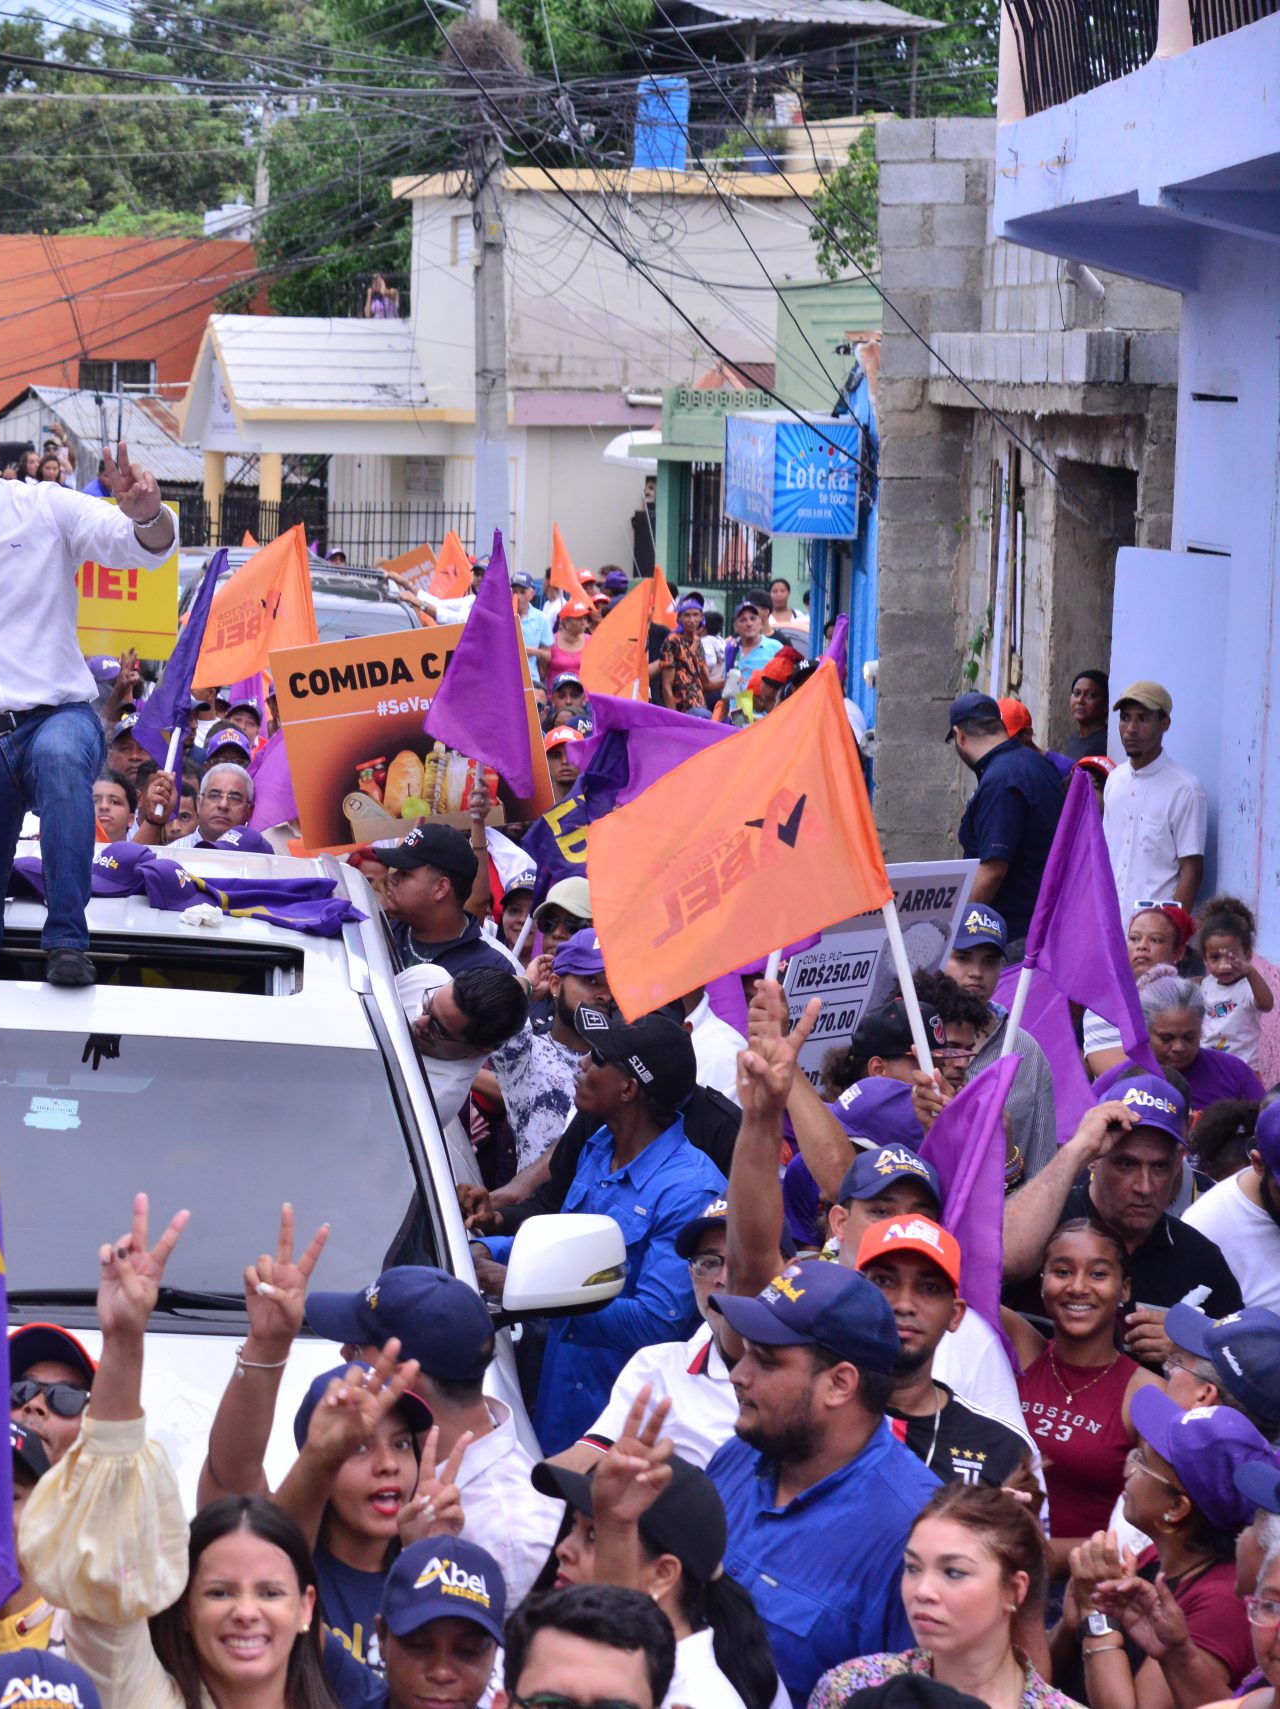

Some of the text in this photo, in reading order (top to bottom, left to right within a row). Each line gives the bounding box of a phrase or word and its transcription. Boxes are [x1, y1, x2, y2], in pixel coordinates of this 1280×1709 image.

[785, 459, 849, 491] Loteka
[288, 657, 415, 699] COMIDA
[901, 886, 958, 912] ARROZ
[964, 909, 1003, 935] Abel
[802, 951, 843, 965] CON EL PLD
[796, 959, 870, 989] RD$250.00
[873, 1149, 929, 1176] Abel
[1020, 1401, 1103, 1435] BOSTON
[1034, 1418, 1073, 1442] 23
[413, 1556, 491, 1600] Abel
